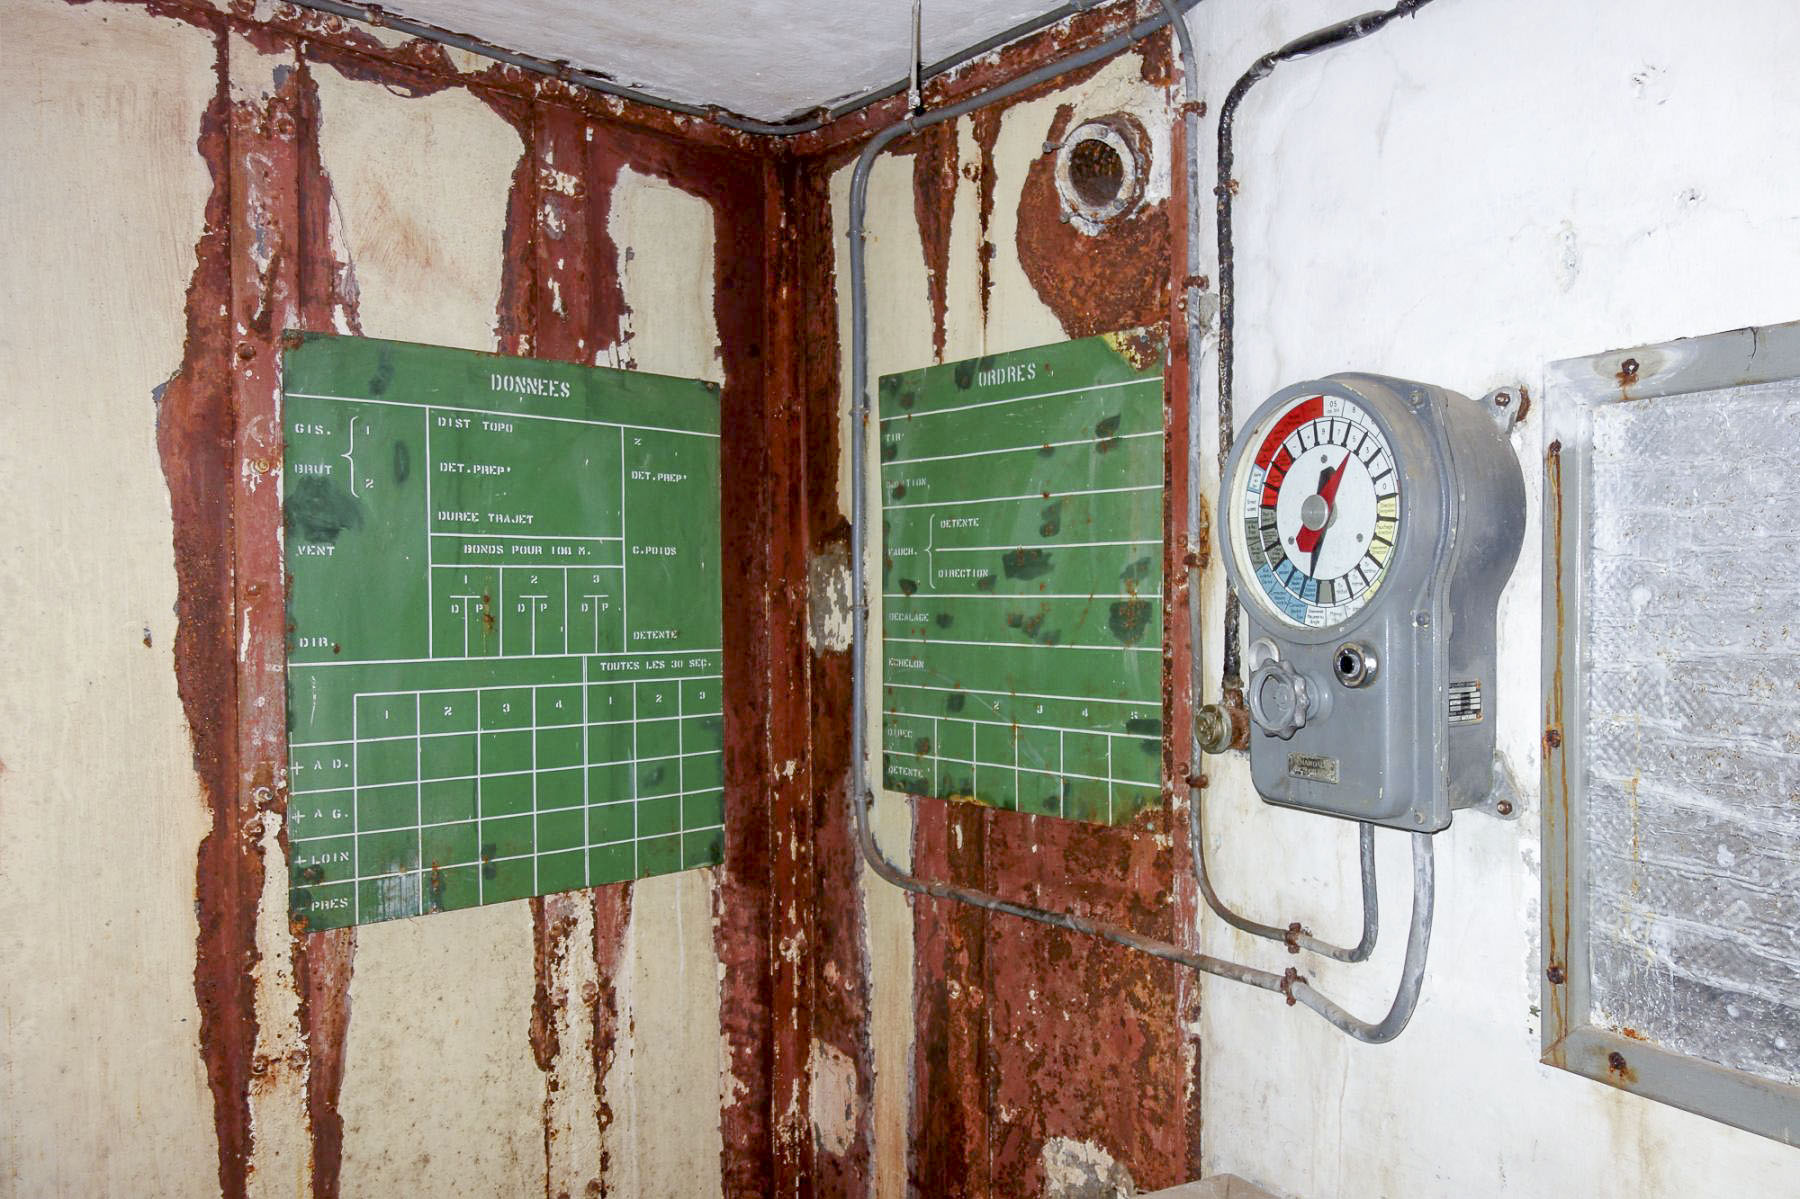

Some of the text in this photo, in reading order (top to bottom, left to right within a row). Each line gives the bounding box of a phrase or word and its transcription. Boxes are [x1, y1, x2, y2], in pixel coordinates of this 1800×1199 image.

[978, 362, 1036, 387] ORDRES
[490, 373, 570, 399] DONNEES
[294, 423, 331, 436] GIS.
[437, 416, 513, 433] DIST TOPO
[633, 437, 642, 446] 2
[294, 462, 333, 475] BRUT
[365, 478, 374, 489] 2
[438, 511, 534, 525] DUREE TRAJET
[940, 517, 980, 529] DETENTE
[295, 545, 335, 557] VENT
[463, 544, 504, 555] BONDS
[511, 545, 543, 555] POUR
[632, 545, 677, 556] C.POIDS
[938, 568, 989, 578] DIRECTION
[530, 575, 538, 584] 2
[592, 574, 600, 584] 3
[540, 603, 548, 613] P
[601, 602, 609, 612] P
[633, 629, 678, 640] DETENTE
[299, 636, 335, 648] DIR.
[599, 661, 640, 671] TOUTES
[645, 660, 666, 670] LES
[671, 659, 684, 669] 30
[608, 696, 613, 705] 1
[655, 694, 663, 703] 2
[444, 706, 452, 716] 2
[502, 703, 510, 713] 3
[385, 709, 389, 720] 1
[313, 759, 323, 770] A
[314, 808, 323, 818] A
[311, 851, 349, 865] LOIN
